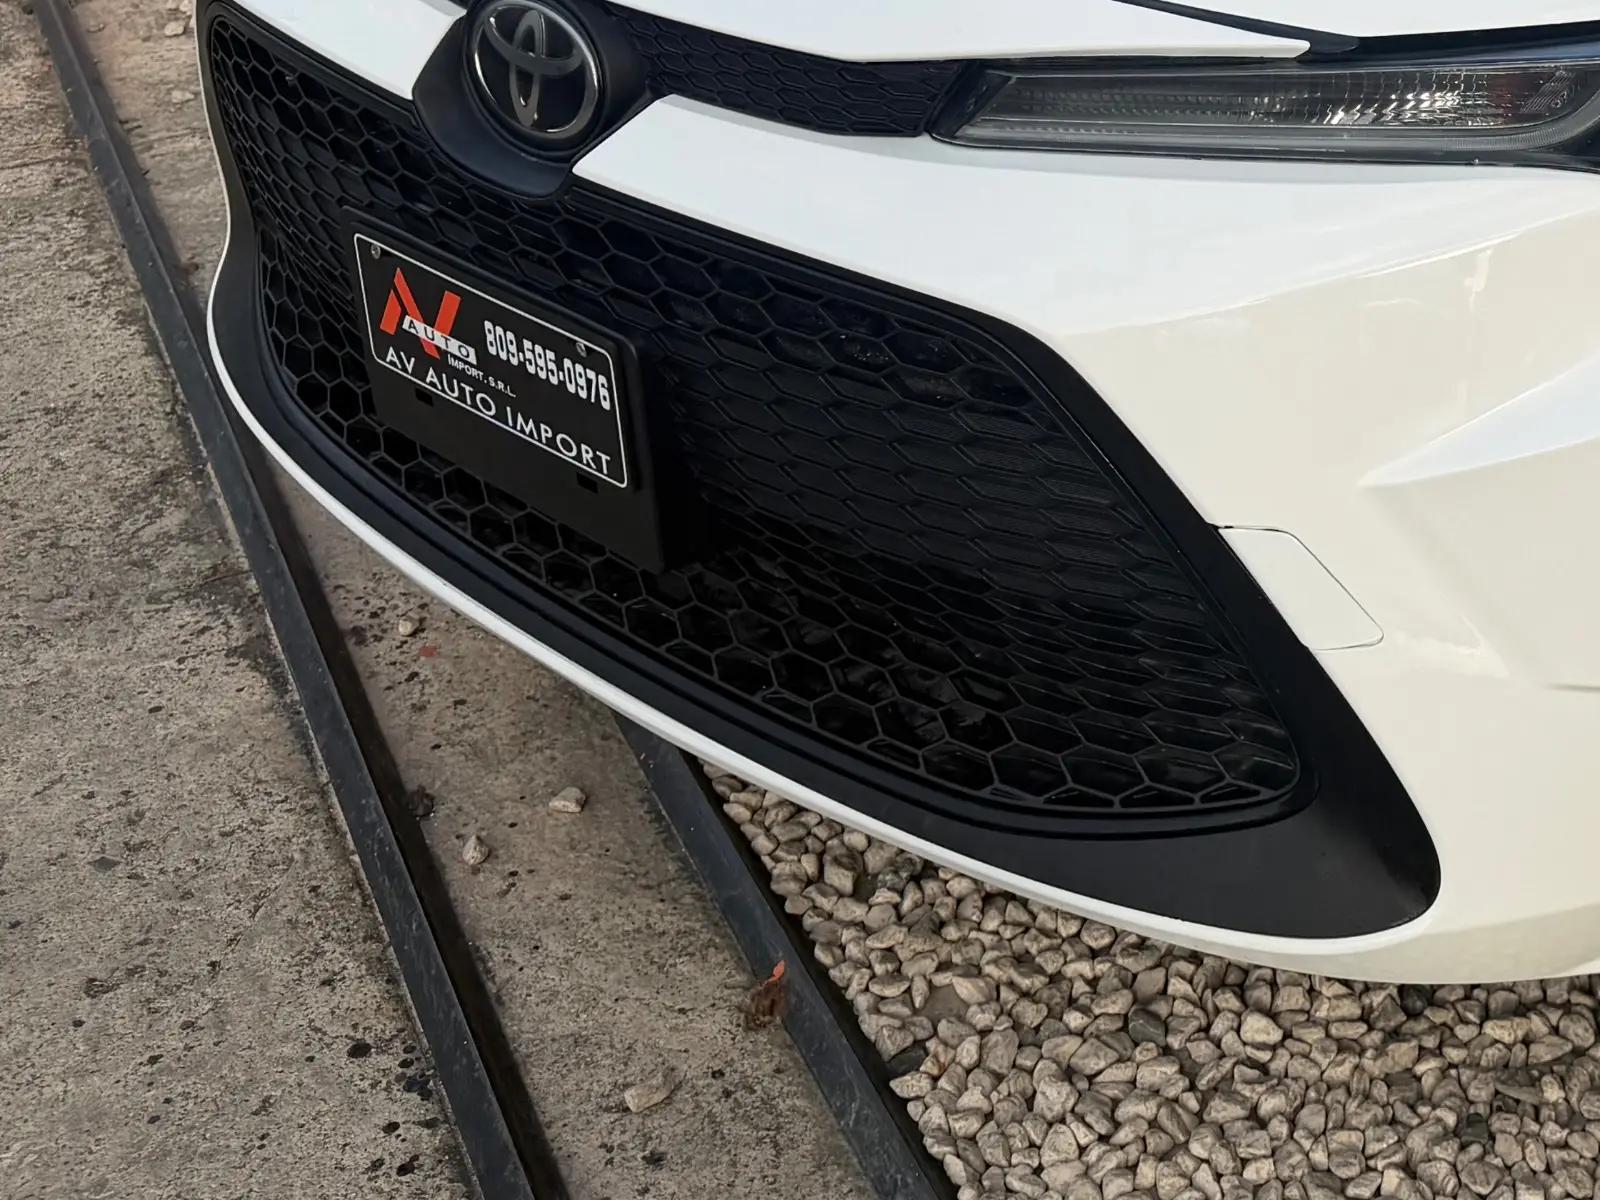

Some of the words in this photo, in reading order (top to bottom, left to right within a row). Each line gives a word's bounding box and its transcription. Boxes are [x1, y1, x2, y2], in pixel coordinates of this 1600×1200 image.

[408, 321, 470, 359] AUTO
[484, 320, 611, 411] 809-595-0976
[386, 346, 415, 374] AV
[425, 367, 496, 416] AUTO
[506, 406, 611, 476] IMPORT
